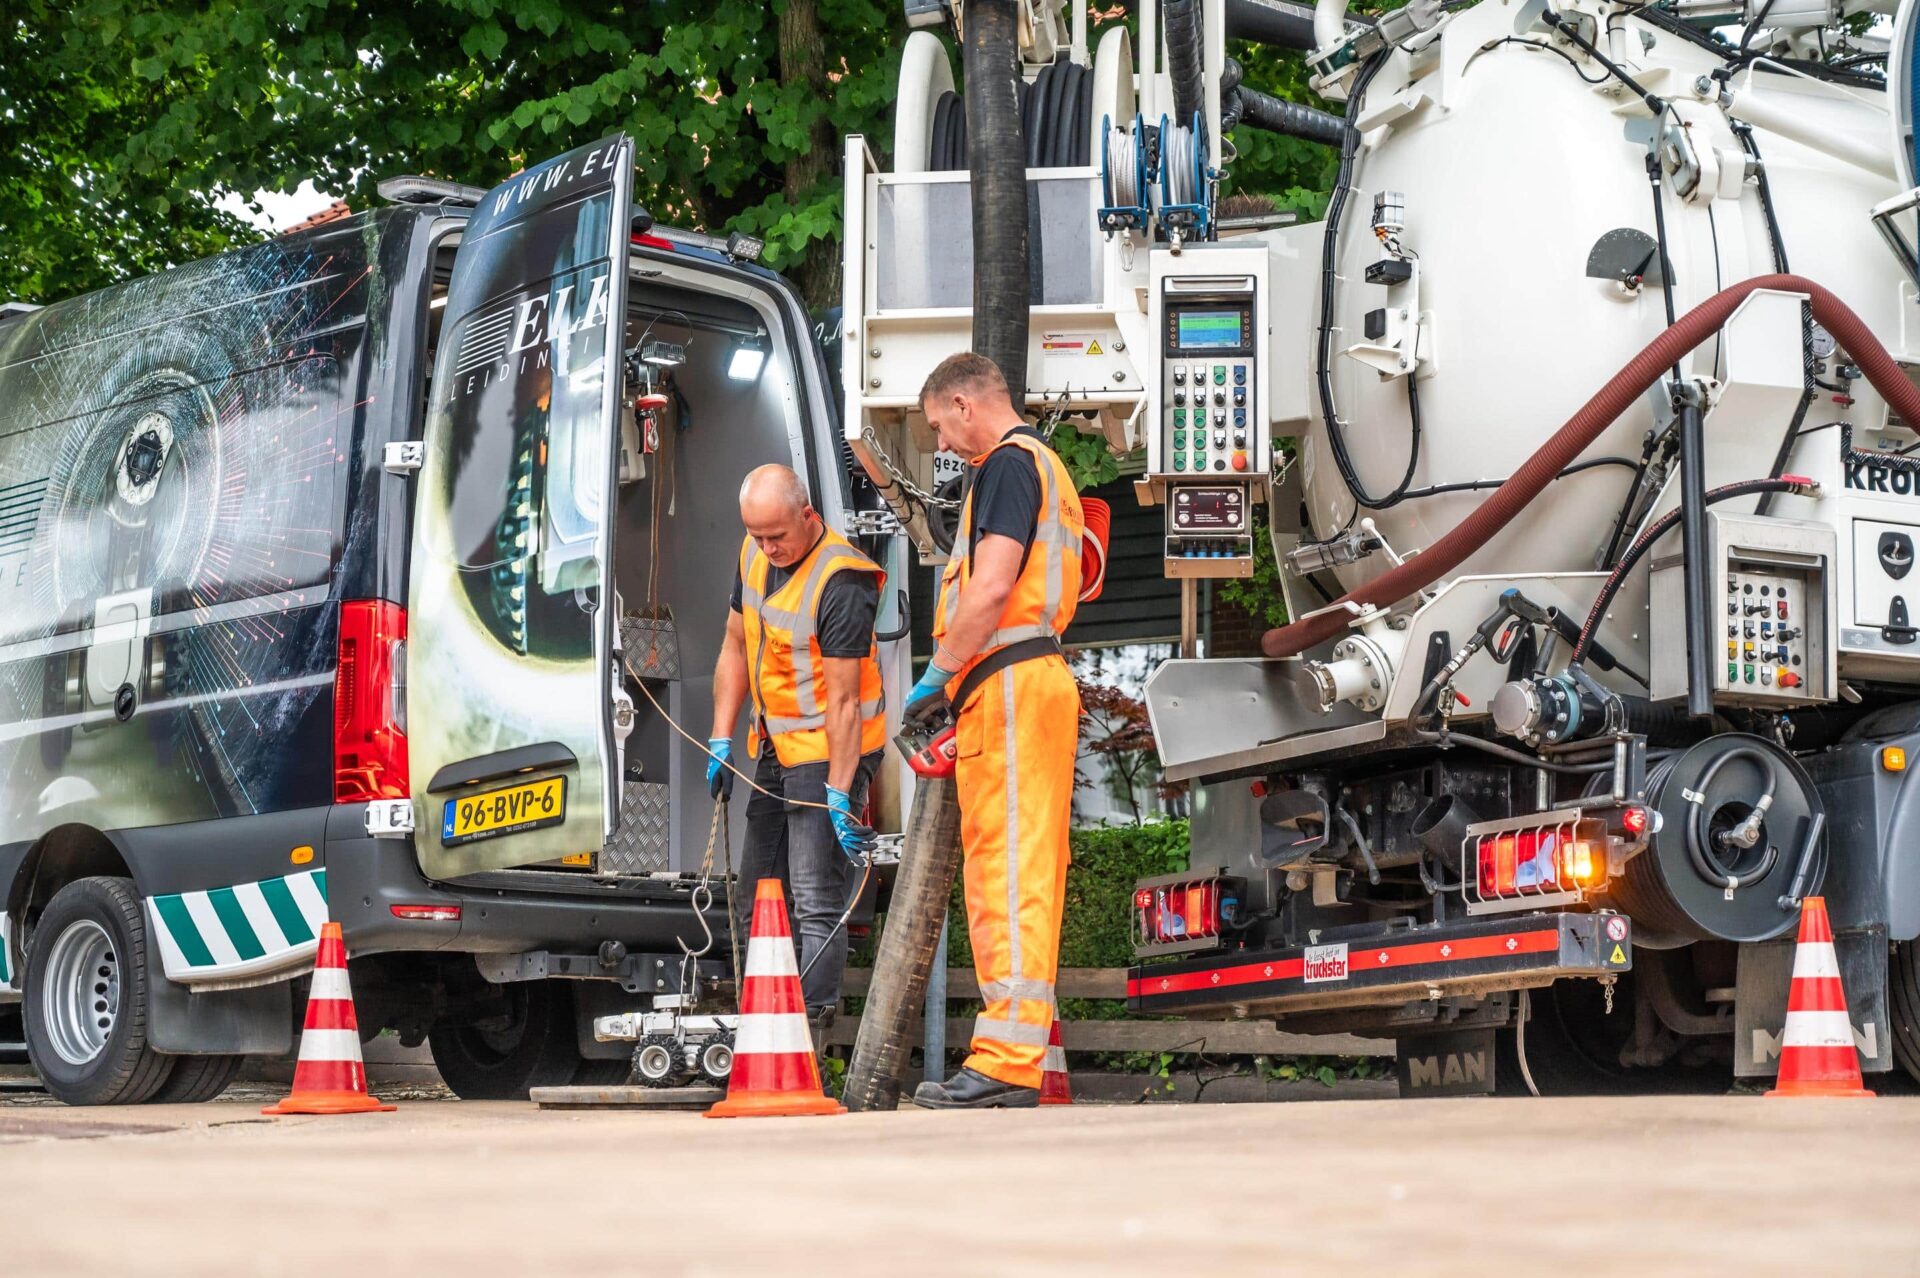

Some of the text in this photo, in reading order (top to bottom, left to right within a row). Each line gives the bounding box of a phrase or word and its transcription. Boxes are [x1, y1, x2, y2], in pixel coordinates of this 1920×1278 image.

[1844, 462, 1920, 497] KRO
[460, 785, 555, 830] 96-BVP-6
[445, 824, 454, 833] NL
[1306, 957, 1346, 980] truckstar
[1752, 1022, 1878, 1064] MN
[1407, 1051, 1487, 1088] MAN
